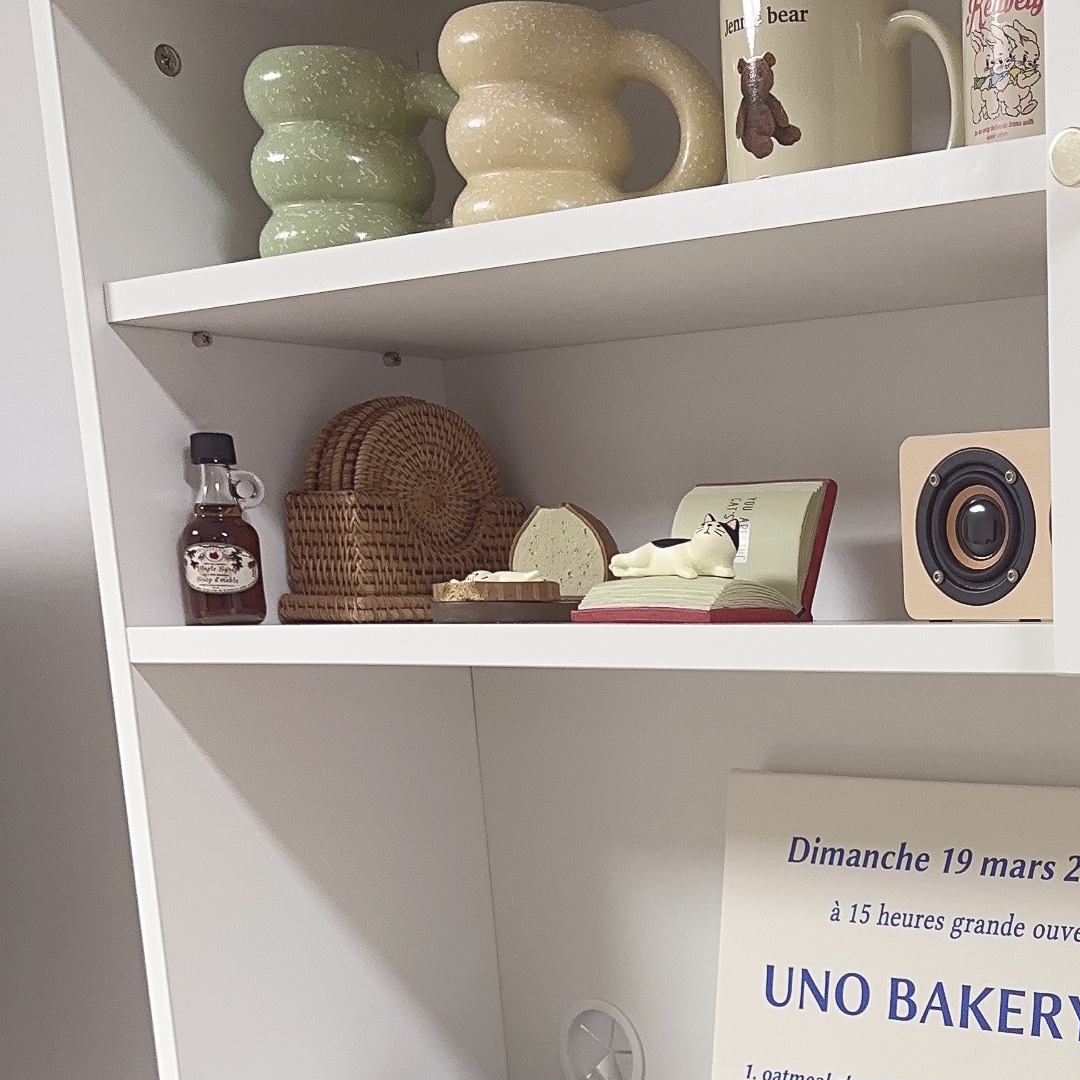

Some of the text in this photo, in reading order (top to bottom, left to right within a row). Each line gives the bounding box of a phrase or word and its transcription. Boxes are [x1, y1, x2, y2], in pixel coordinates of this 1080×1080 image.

[766, 6, 809, 25] bear
[723, 498, 742, 520] CAT'S
[742, 496, 758, 511] YOU
[787, 836, 930, 873] Dimanche
[942, 847, 973, 875] 19
[979, 854, 1056, 882] mars
[829, 900, 841, 922] à
[847, 902, 871, 925] 15
[876, 903, 945, 931] heures
[949, 913, 1026, 939] grande
[765, 964, 871, 1016] UNO
[745, 1063, 757, 1080] 1.
